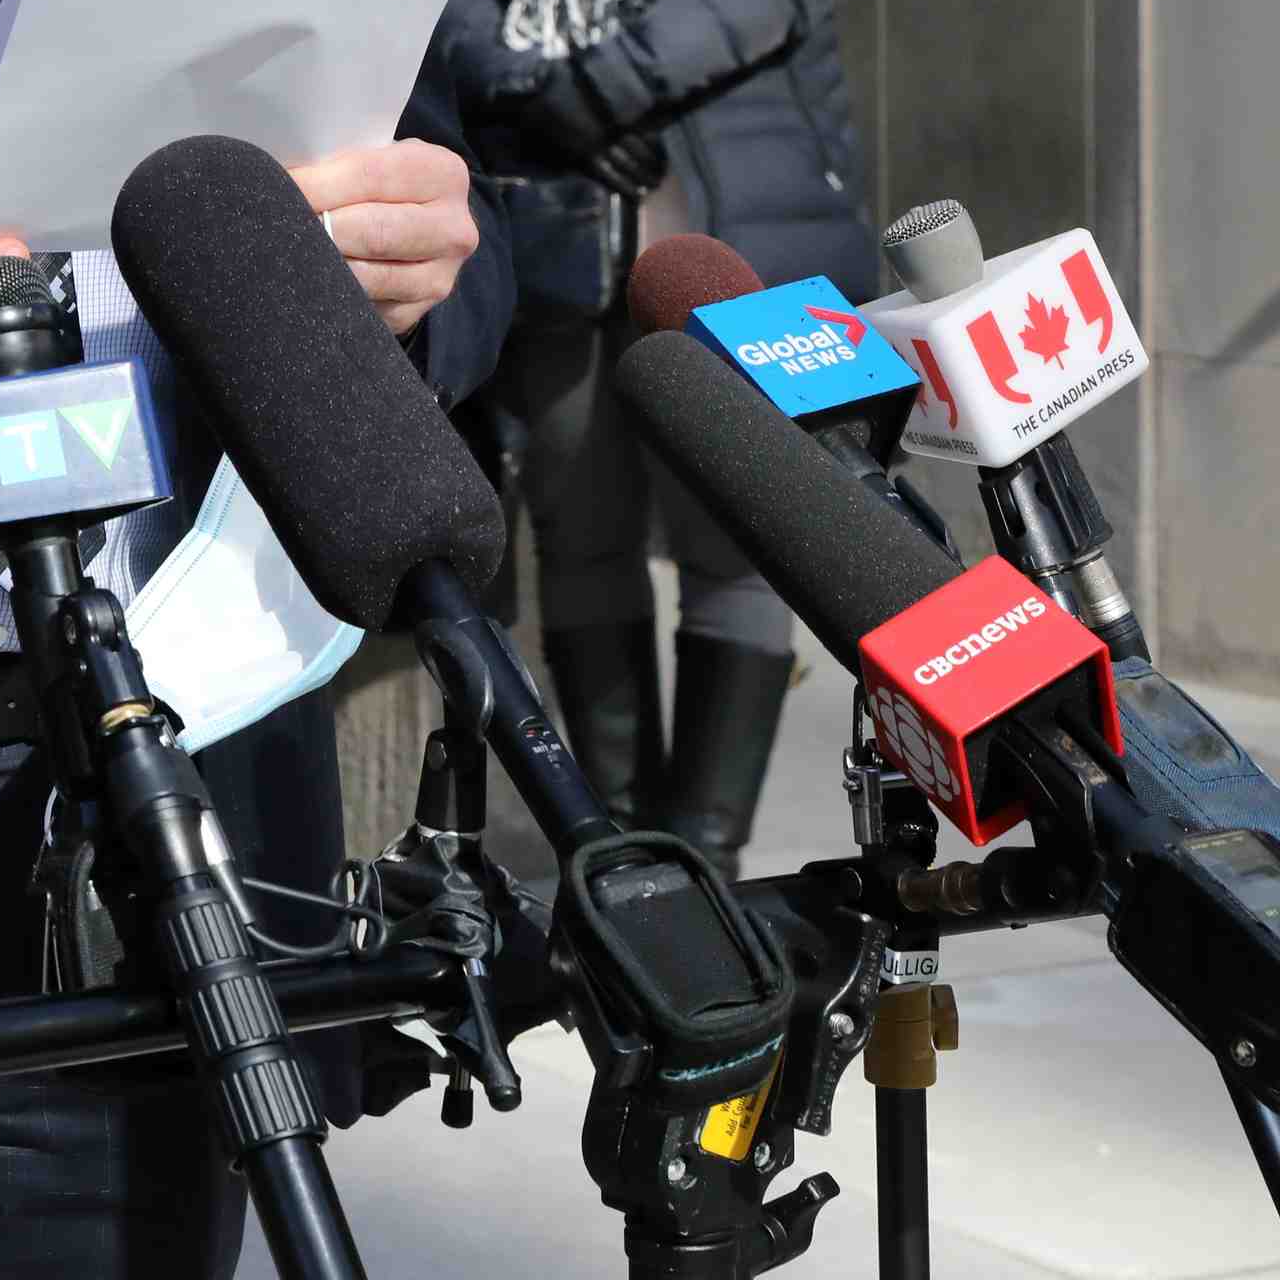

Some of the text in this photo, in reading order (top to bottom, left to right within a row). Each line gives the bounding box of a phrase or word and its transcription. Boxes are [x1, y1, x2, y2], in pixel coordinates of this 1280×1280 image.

[737, 323, 843, 366] Global
[779, 344, 857, 376] NEWS
[1012, 348, 1136, 439] THE CANADIAN PRESS
[882, 955, 939, 977] ULLIG
